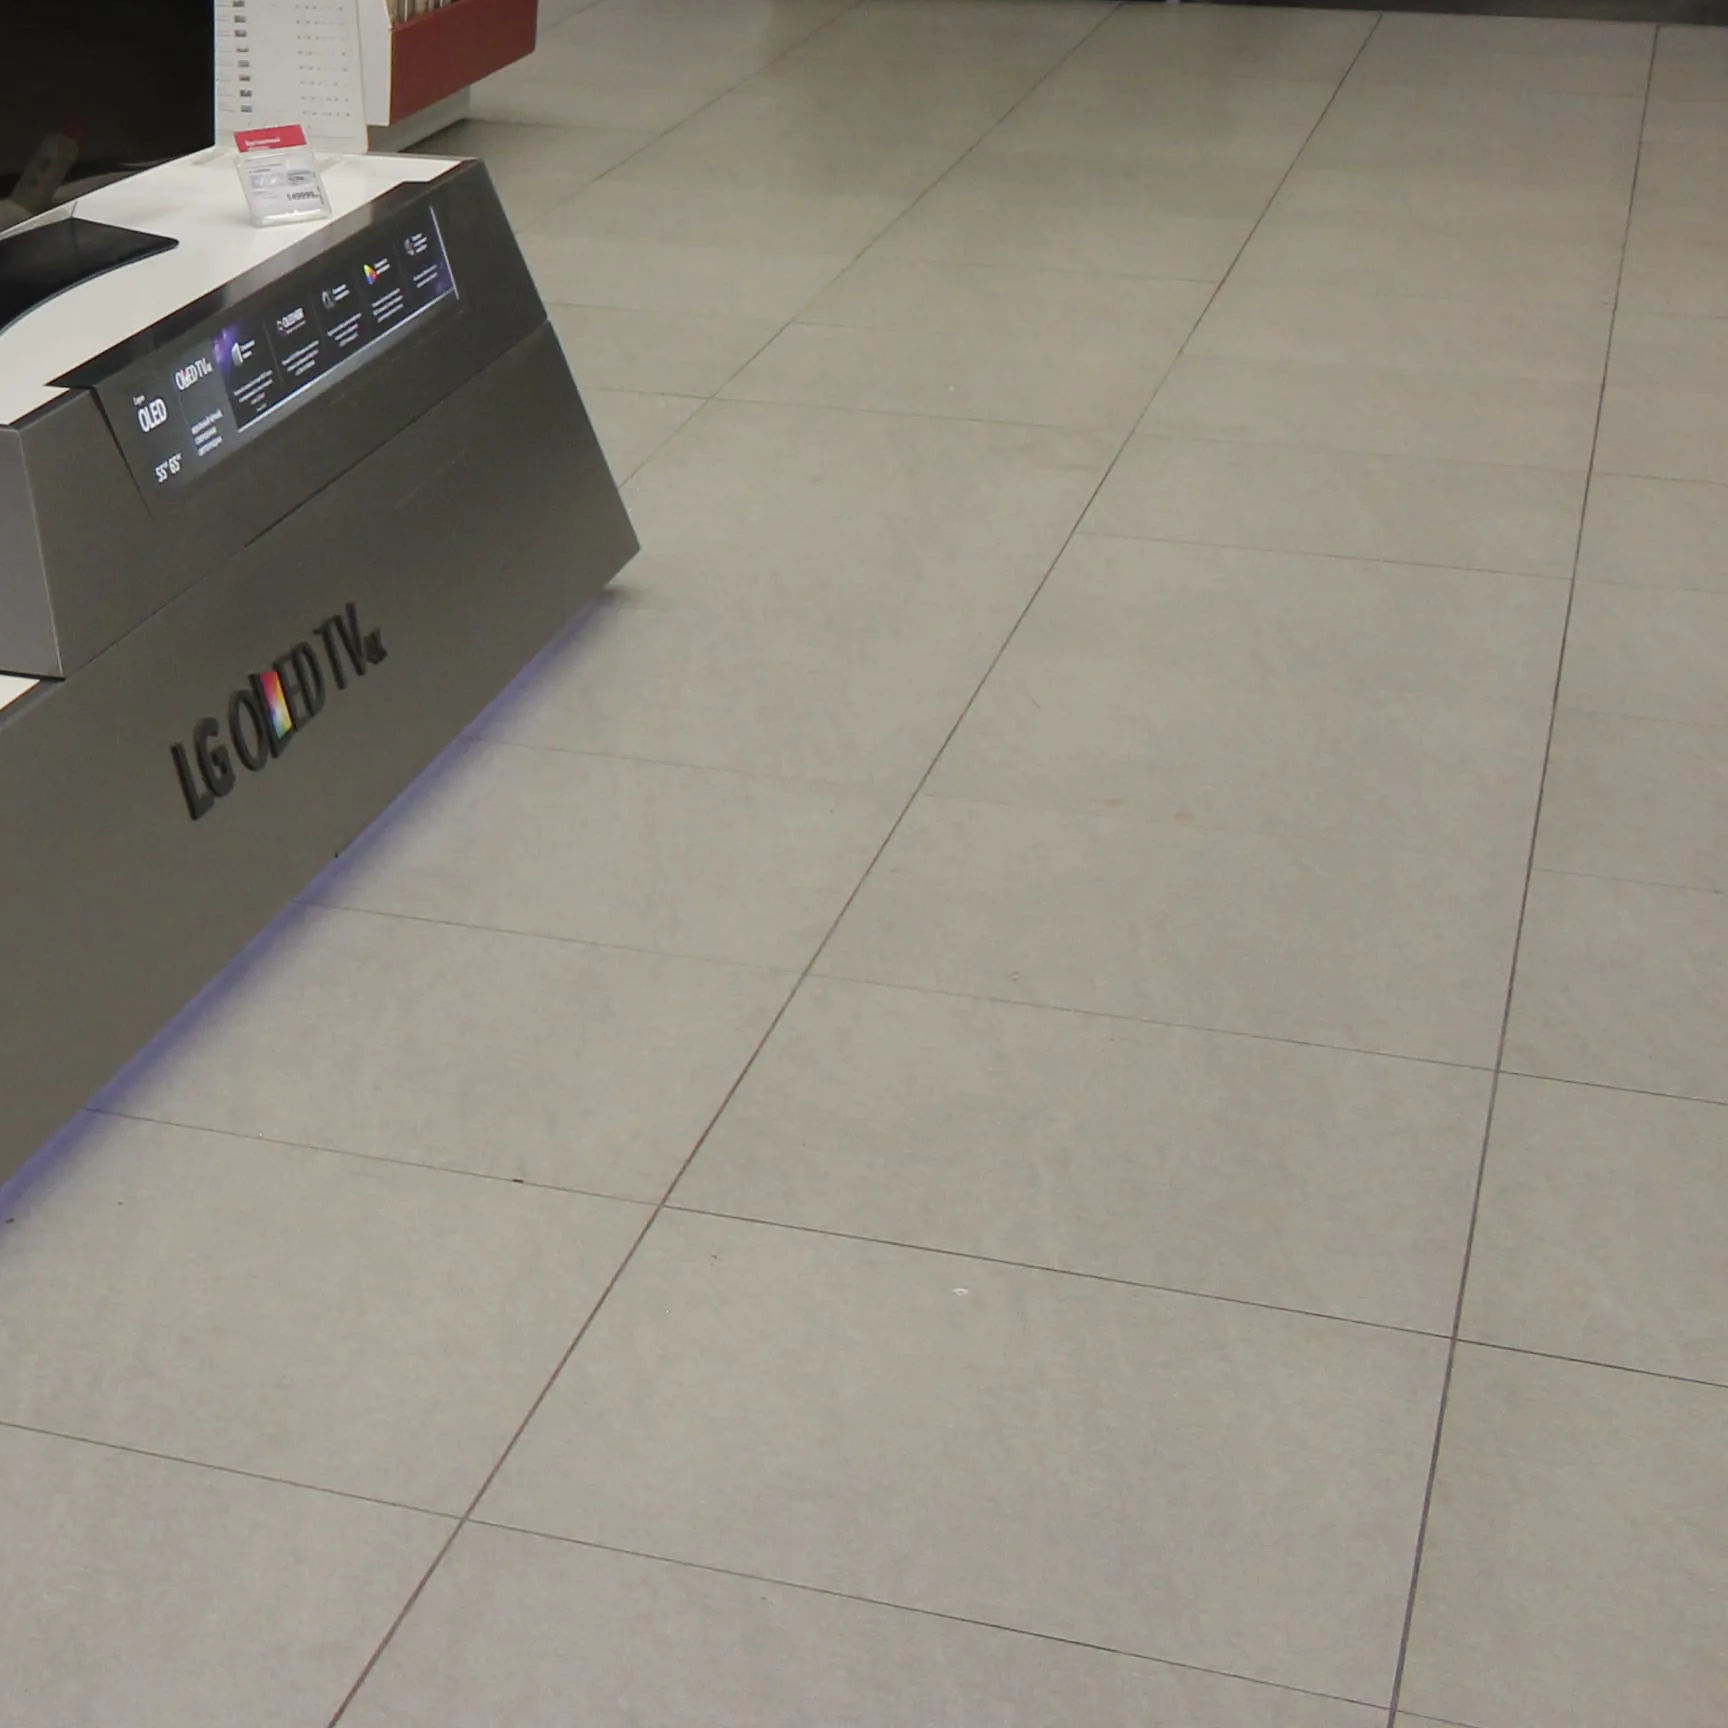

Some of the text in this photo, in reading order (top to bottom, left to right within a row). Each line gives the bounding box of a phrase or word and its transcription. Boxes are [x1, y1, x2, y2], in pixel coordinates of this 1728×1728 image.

[138, 398, 168, 432] OLED
[170, 717, 236, 821] LG
[227, 641, 326, 772] OLED
[312, 602, 367, 690] TV
